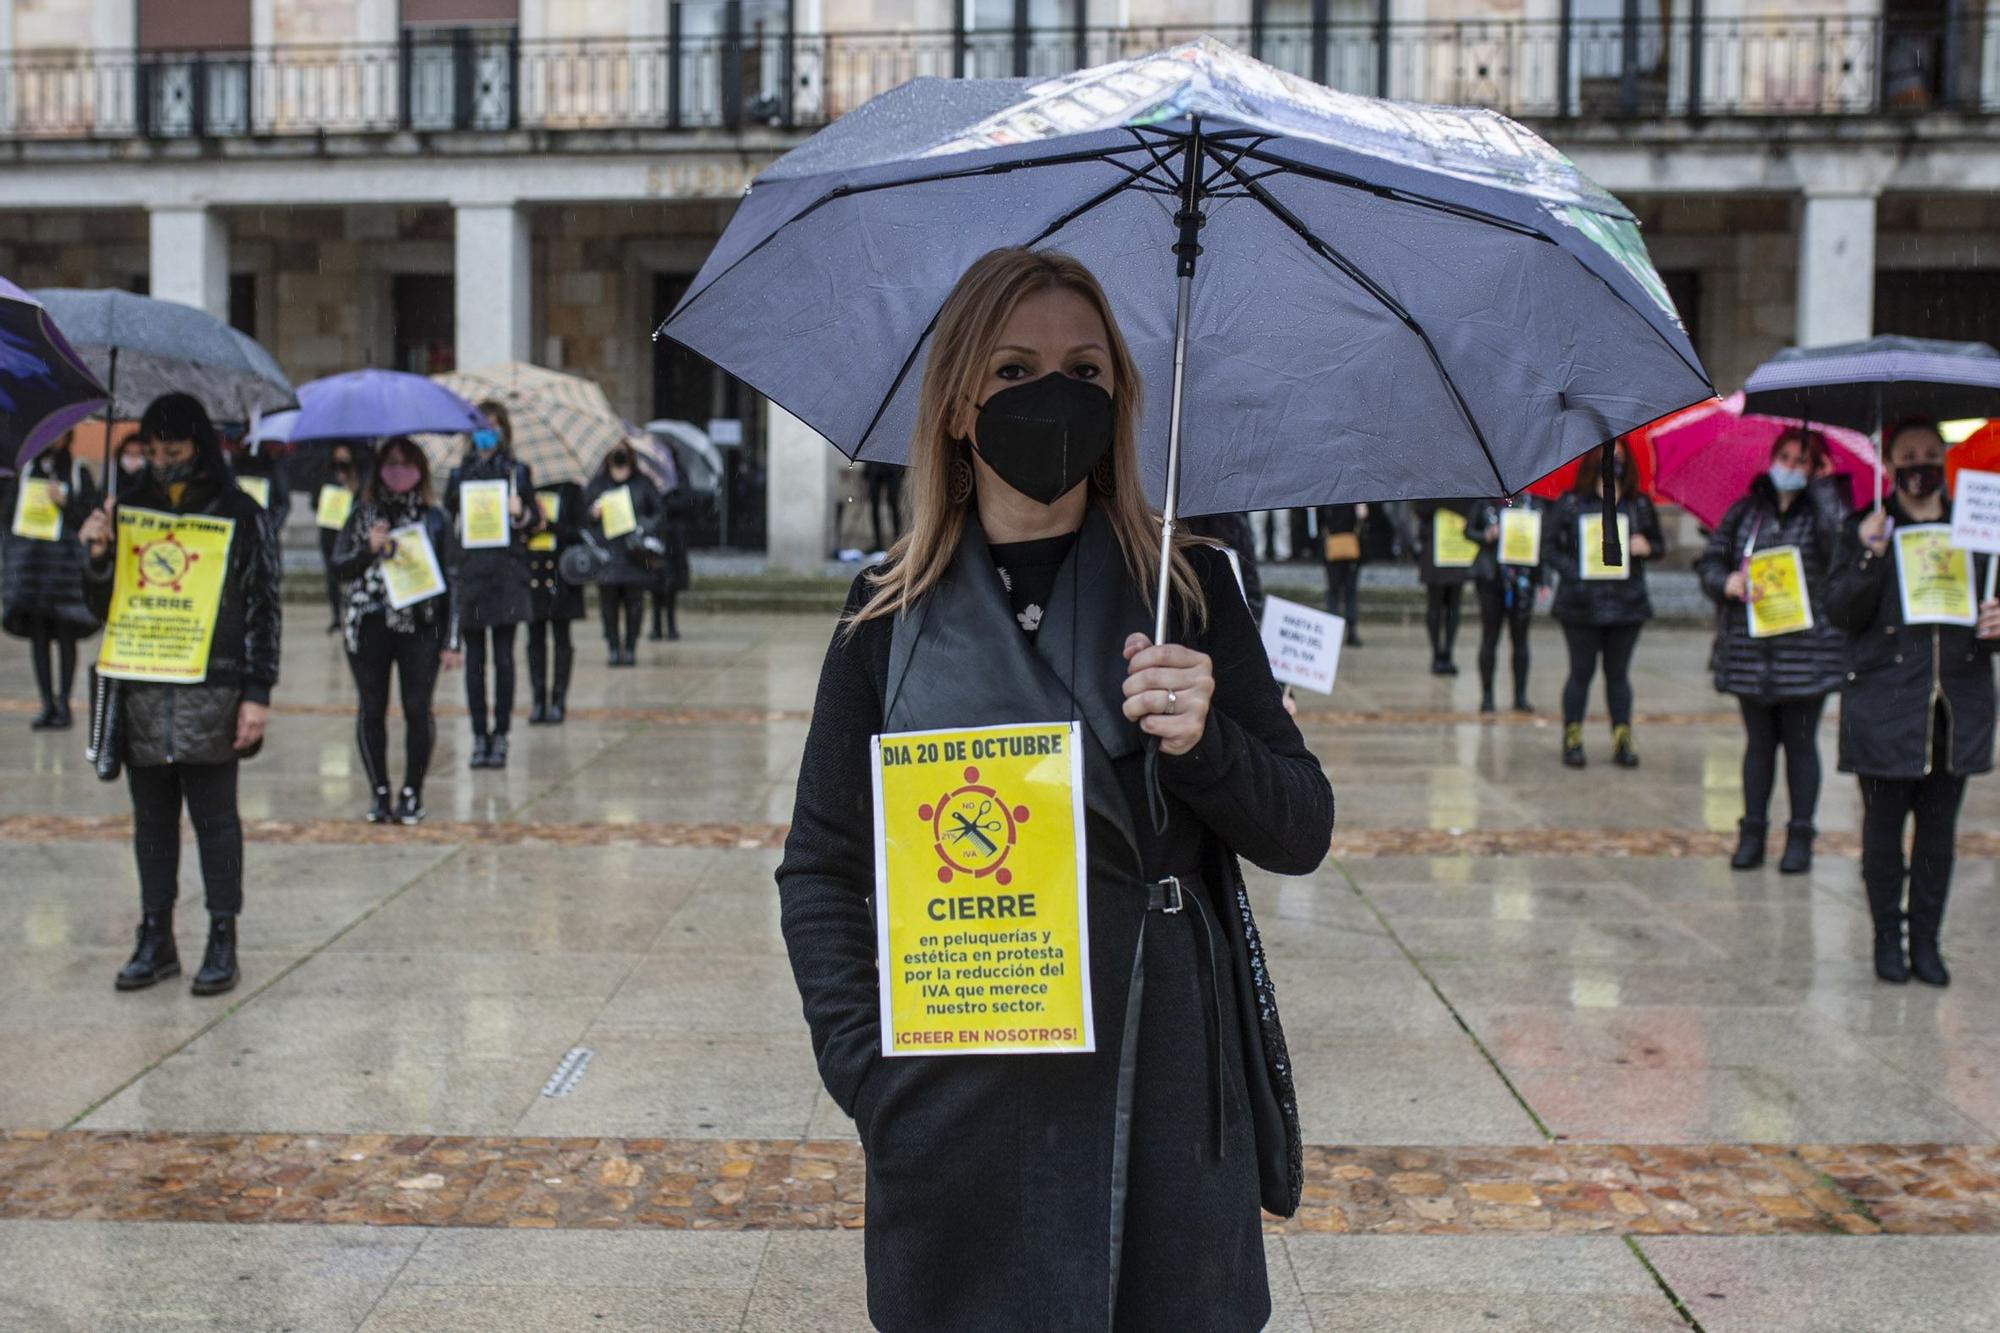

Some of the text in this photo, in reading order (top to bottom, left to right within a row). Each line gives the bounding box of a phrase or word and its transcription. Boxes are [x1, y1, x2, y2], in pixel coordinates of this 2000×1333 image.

[883, 734, 1062, 766] DIA 20 DE OCTUBRE
[963, 850, 977, 858] IVA
[928, 894, 1036, 921] CIERRE
[920, 929, 1051, 948] en peluquerías y
[904, 947, 1063, 964] estética en protesta
[905, 962, 1064, 984] por la reducción del
[922, 984, 1048, 999] IVA que merece
[927, 1000, 1045, 1014] nuestro sector.
[896, 1028, 1077, 1045] ¡CREER EN NOSOTROS!
